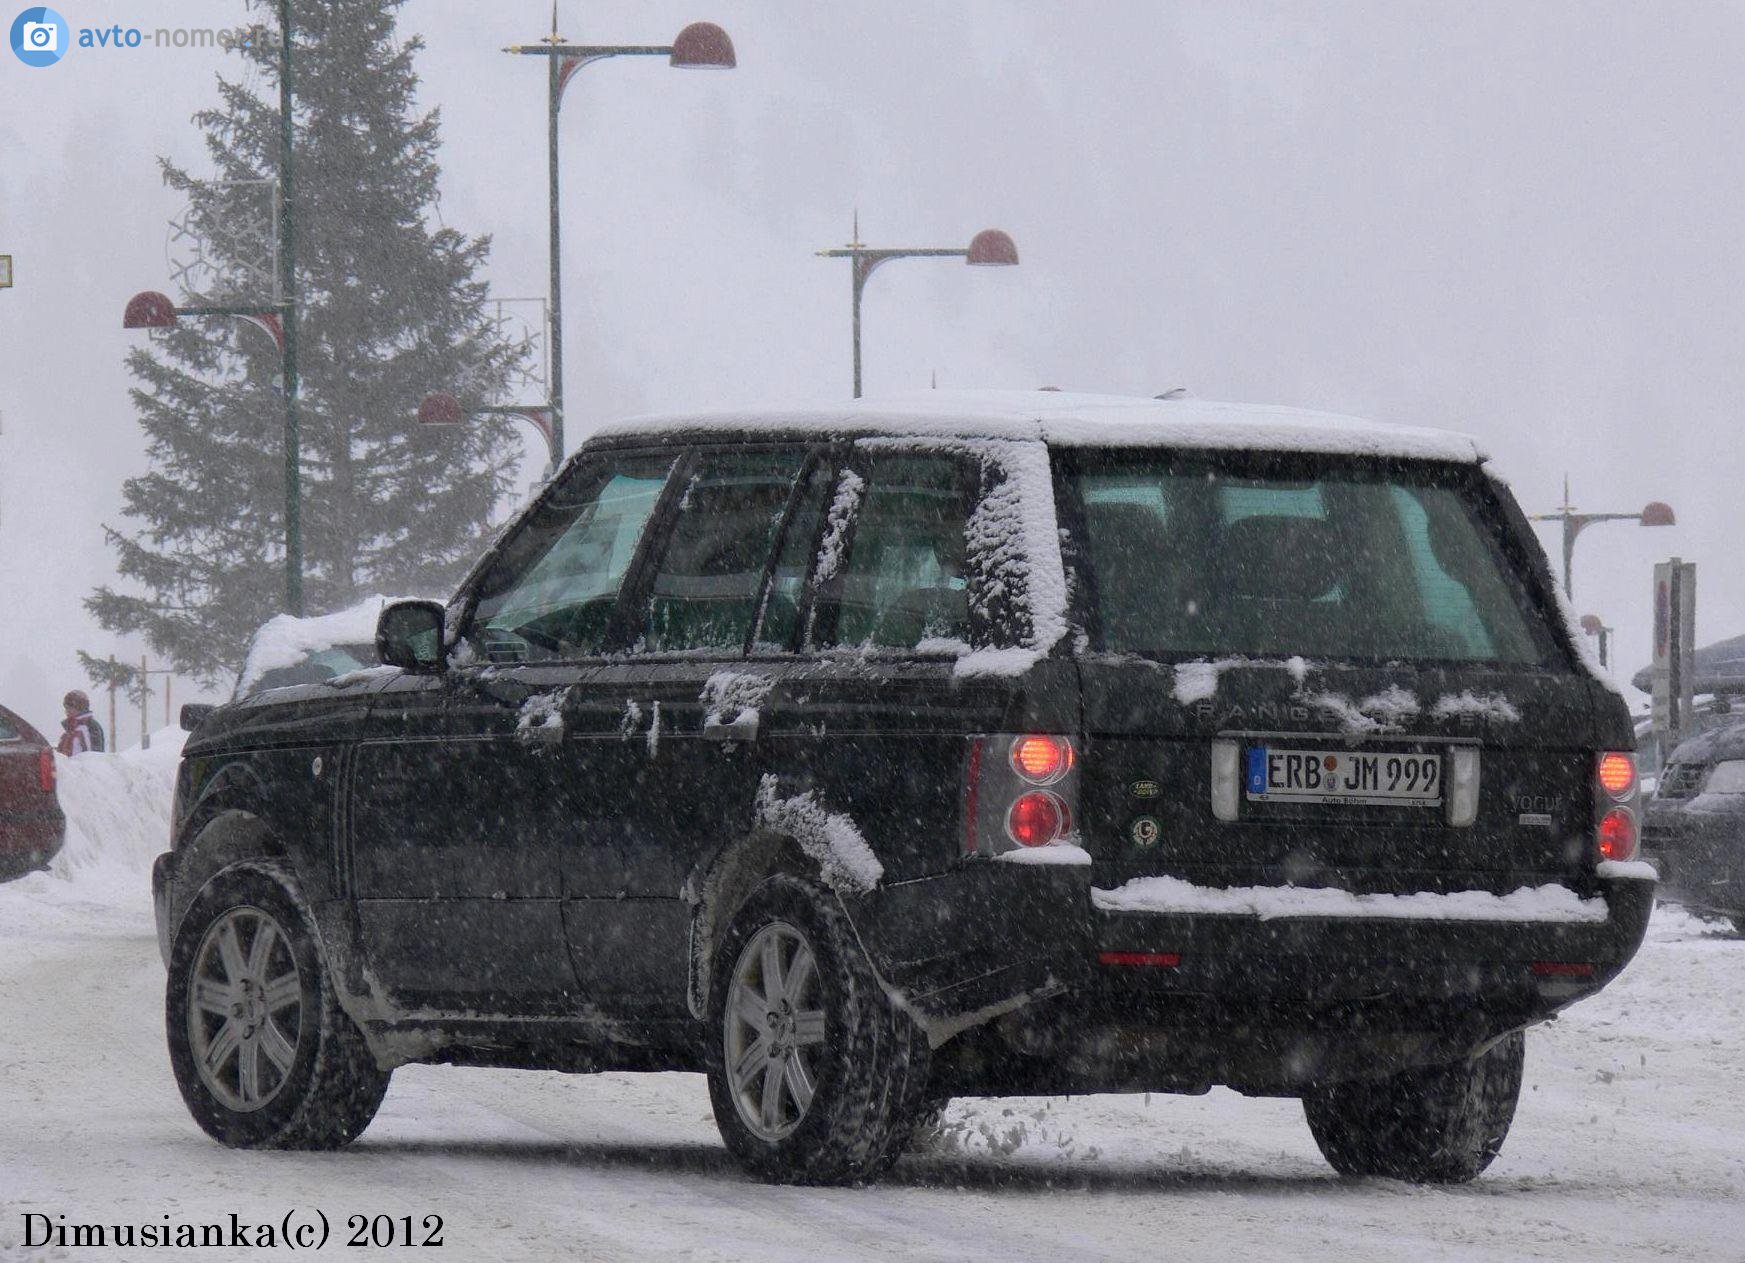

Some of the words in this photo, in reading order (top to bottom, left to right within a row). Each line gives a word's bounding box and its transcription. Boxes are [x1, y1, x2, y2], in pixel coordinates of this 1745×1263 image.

[1268, 754, 1321, 788] ERB
[1344, 756, 1379, 790] JM
[1387, 758, 1437, 792] 999
